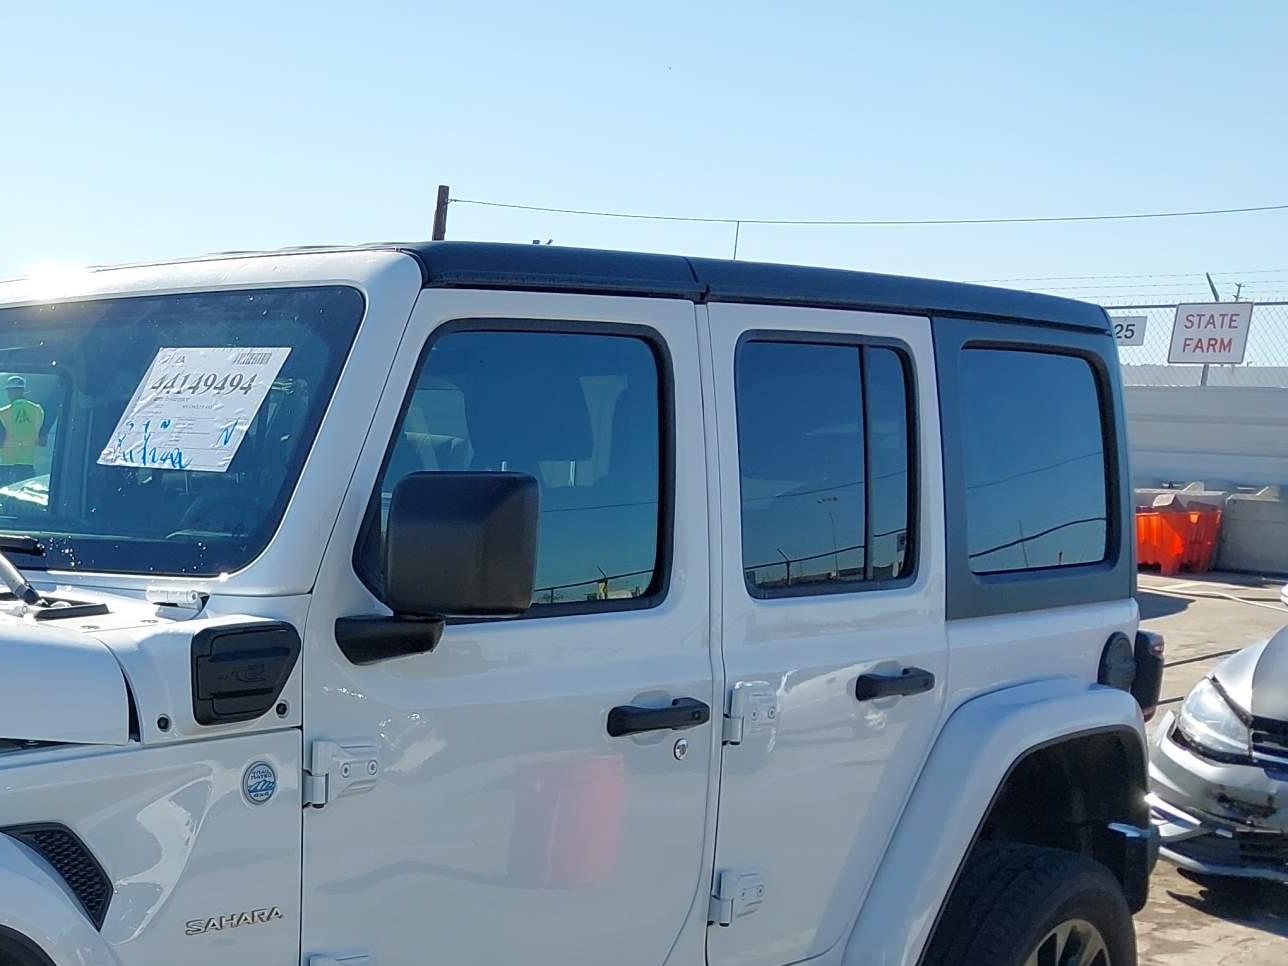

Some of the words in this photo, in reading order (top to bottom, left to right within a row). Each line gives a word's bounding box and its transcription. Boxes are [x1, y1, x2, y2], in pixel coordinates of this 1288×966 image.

[1184, 313, 1241, 329] STATE
[1114, 323, 1136, 340] 25
[1182, 337, 1233, 353] FARM
[150, 372, 258, 396] 44149494
[184, 905, 285, 936] SAHARA
